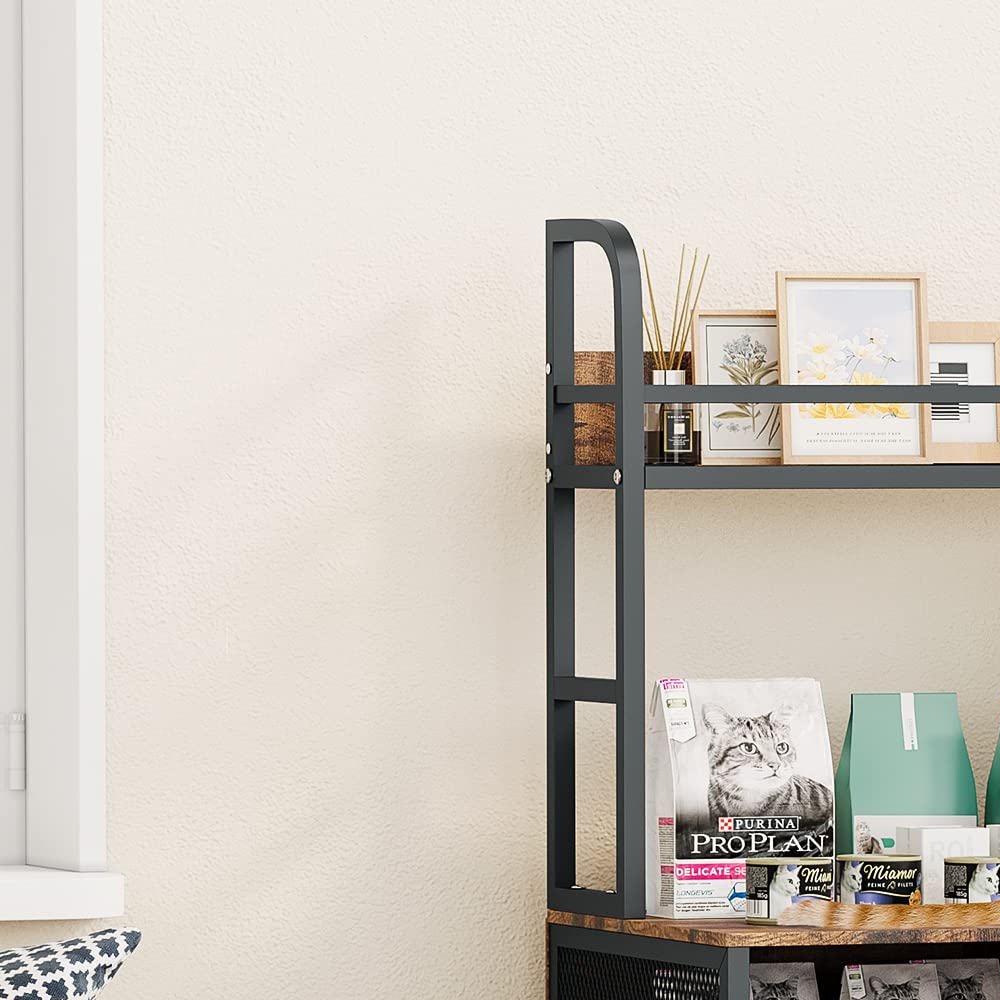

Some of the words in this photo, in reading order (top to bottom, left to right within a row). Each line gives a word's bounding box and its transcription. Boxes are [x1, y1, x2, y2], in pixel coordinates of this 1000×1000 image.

[735, 818, 796, 830] PURINA
[676, 866, 730, 876] DELICATE
[864, 865, 917, 880] Miamor
